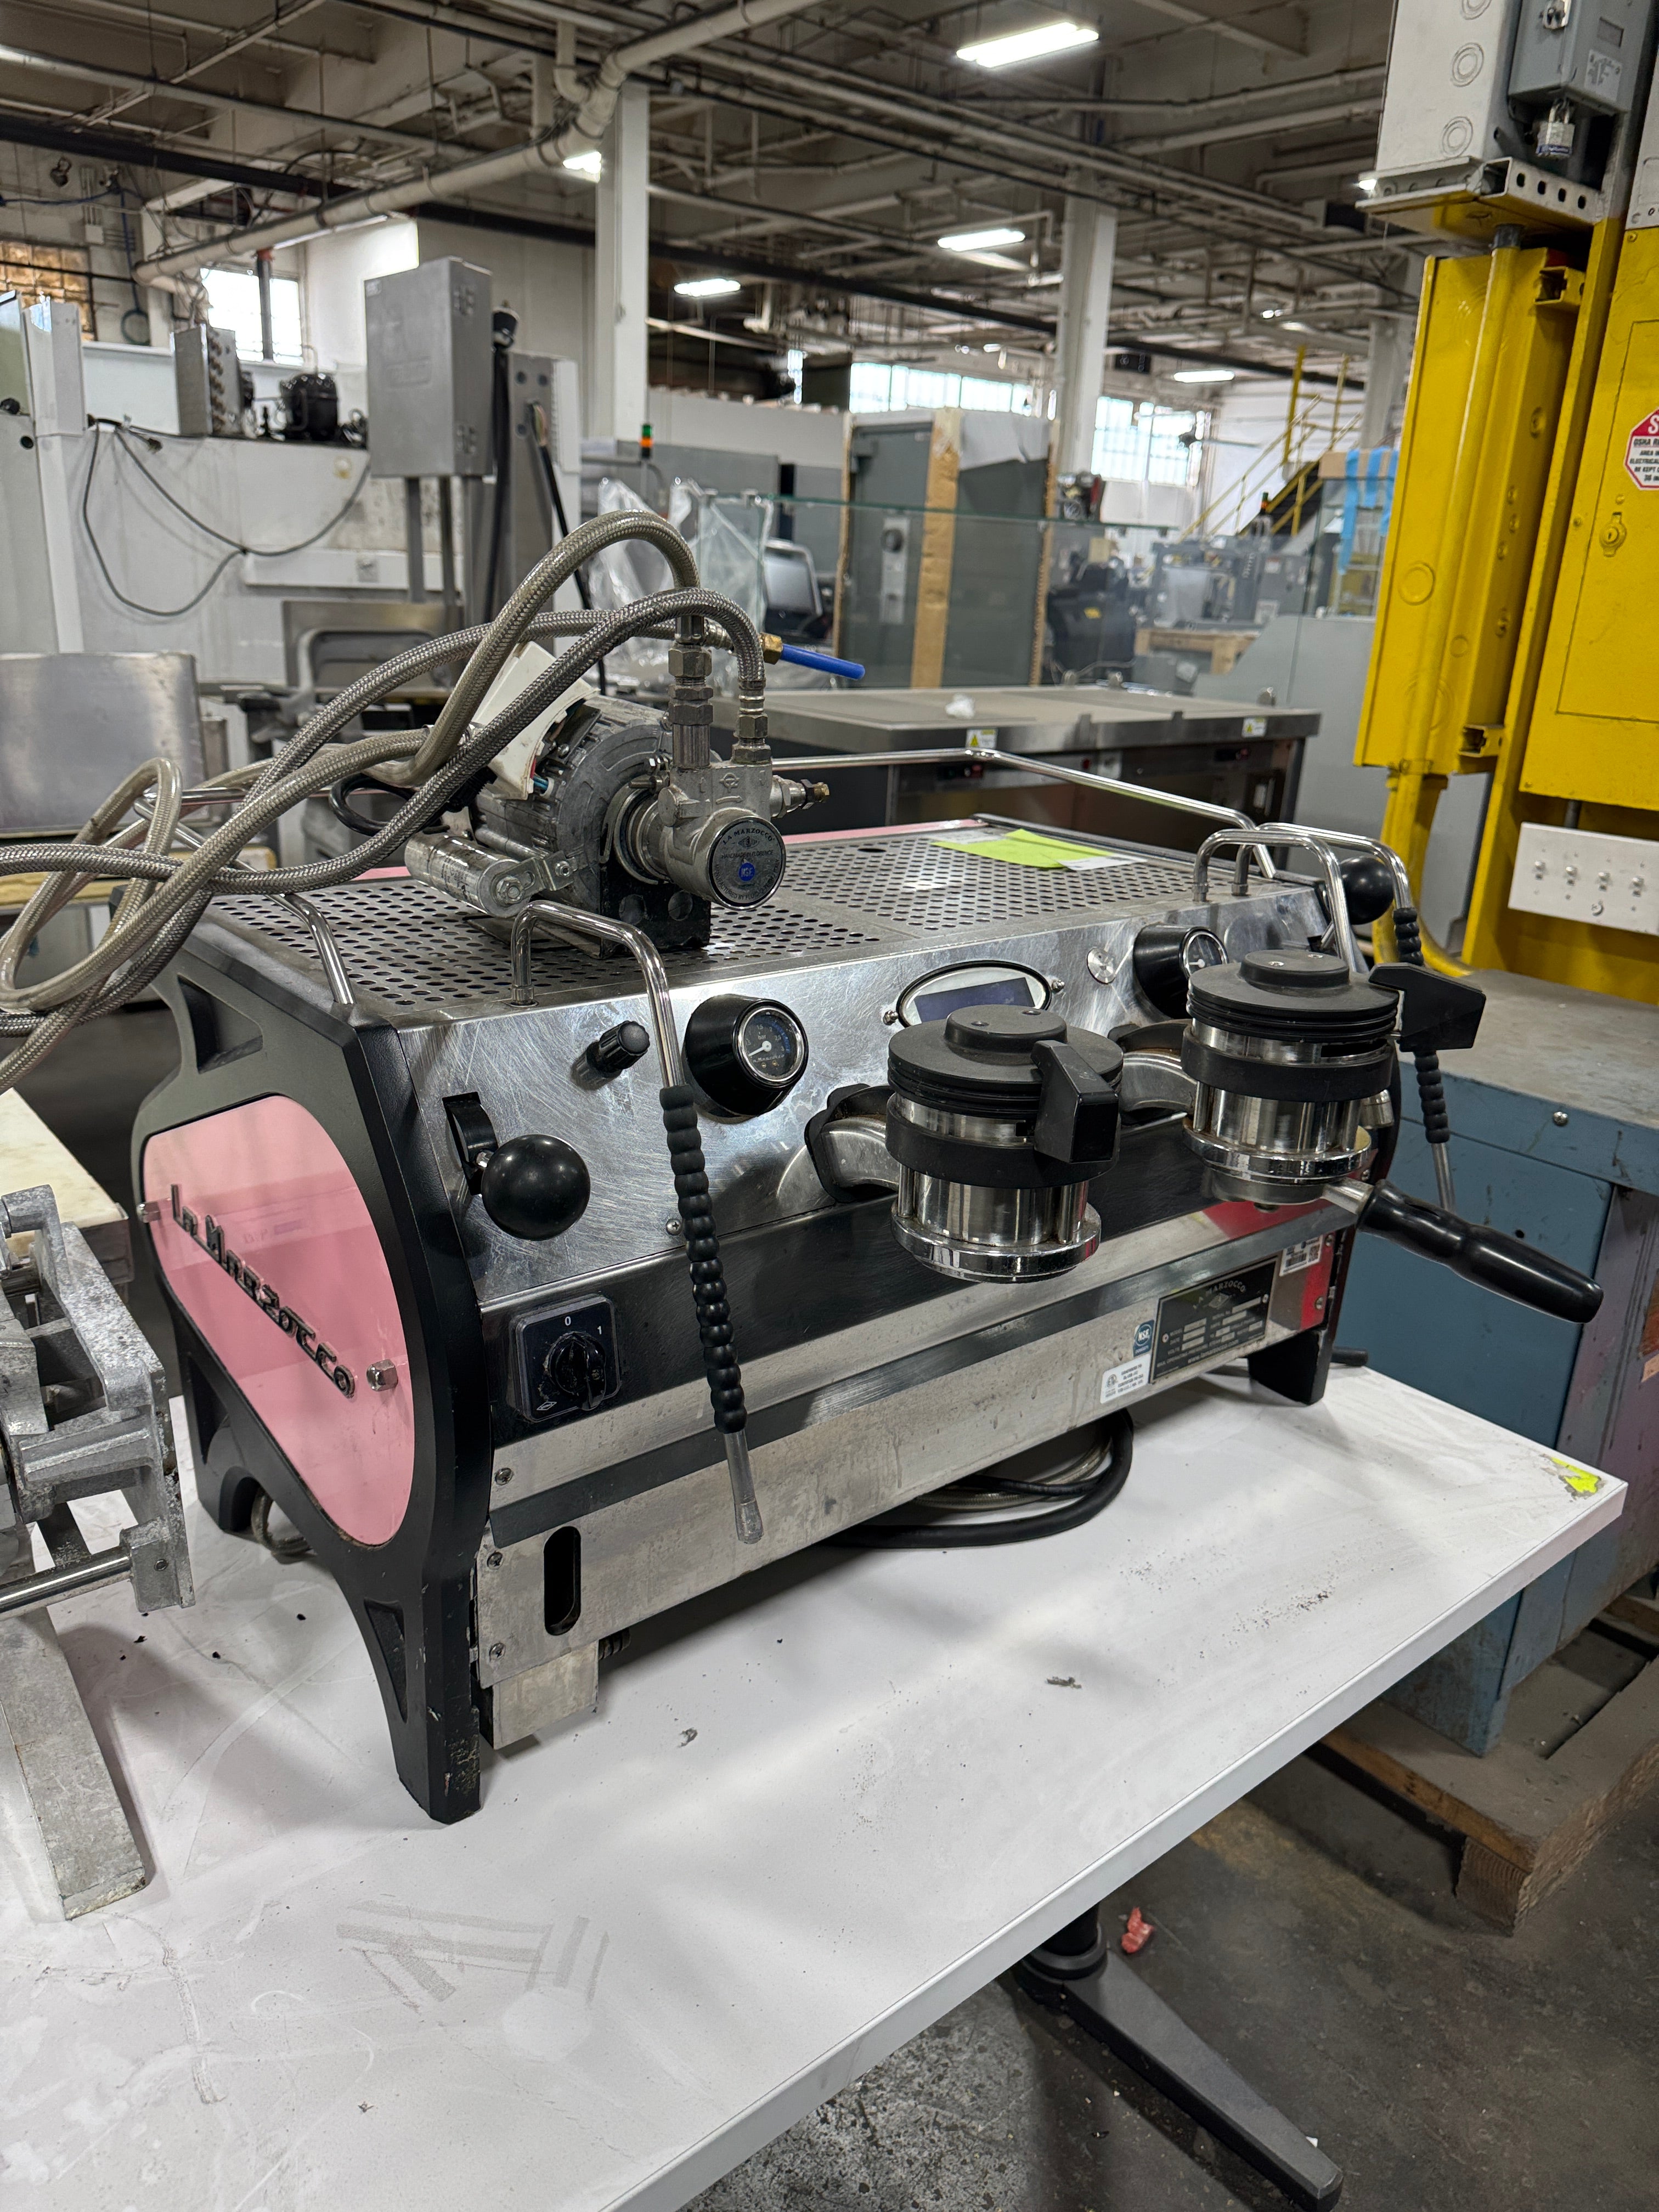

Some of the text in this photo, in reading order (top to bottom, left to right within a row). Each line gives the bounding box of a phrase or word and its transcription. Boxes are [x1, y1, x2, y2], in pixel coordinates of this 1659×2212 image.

[723, 828, 773, 845] LA MARZOCCO
[565, 1316, 571, 1326] 0
[597, 1325, 602, 1335] 1
